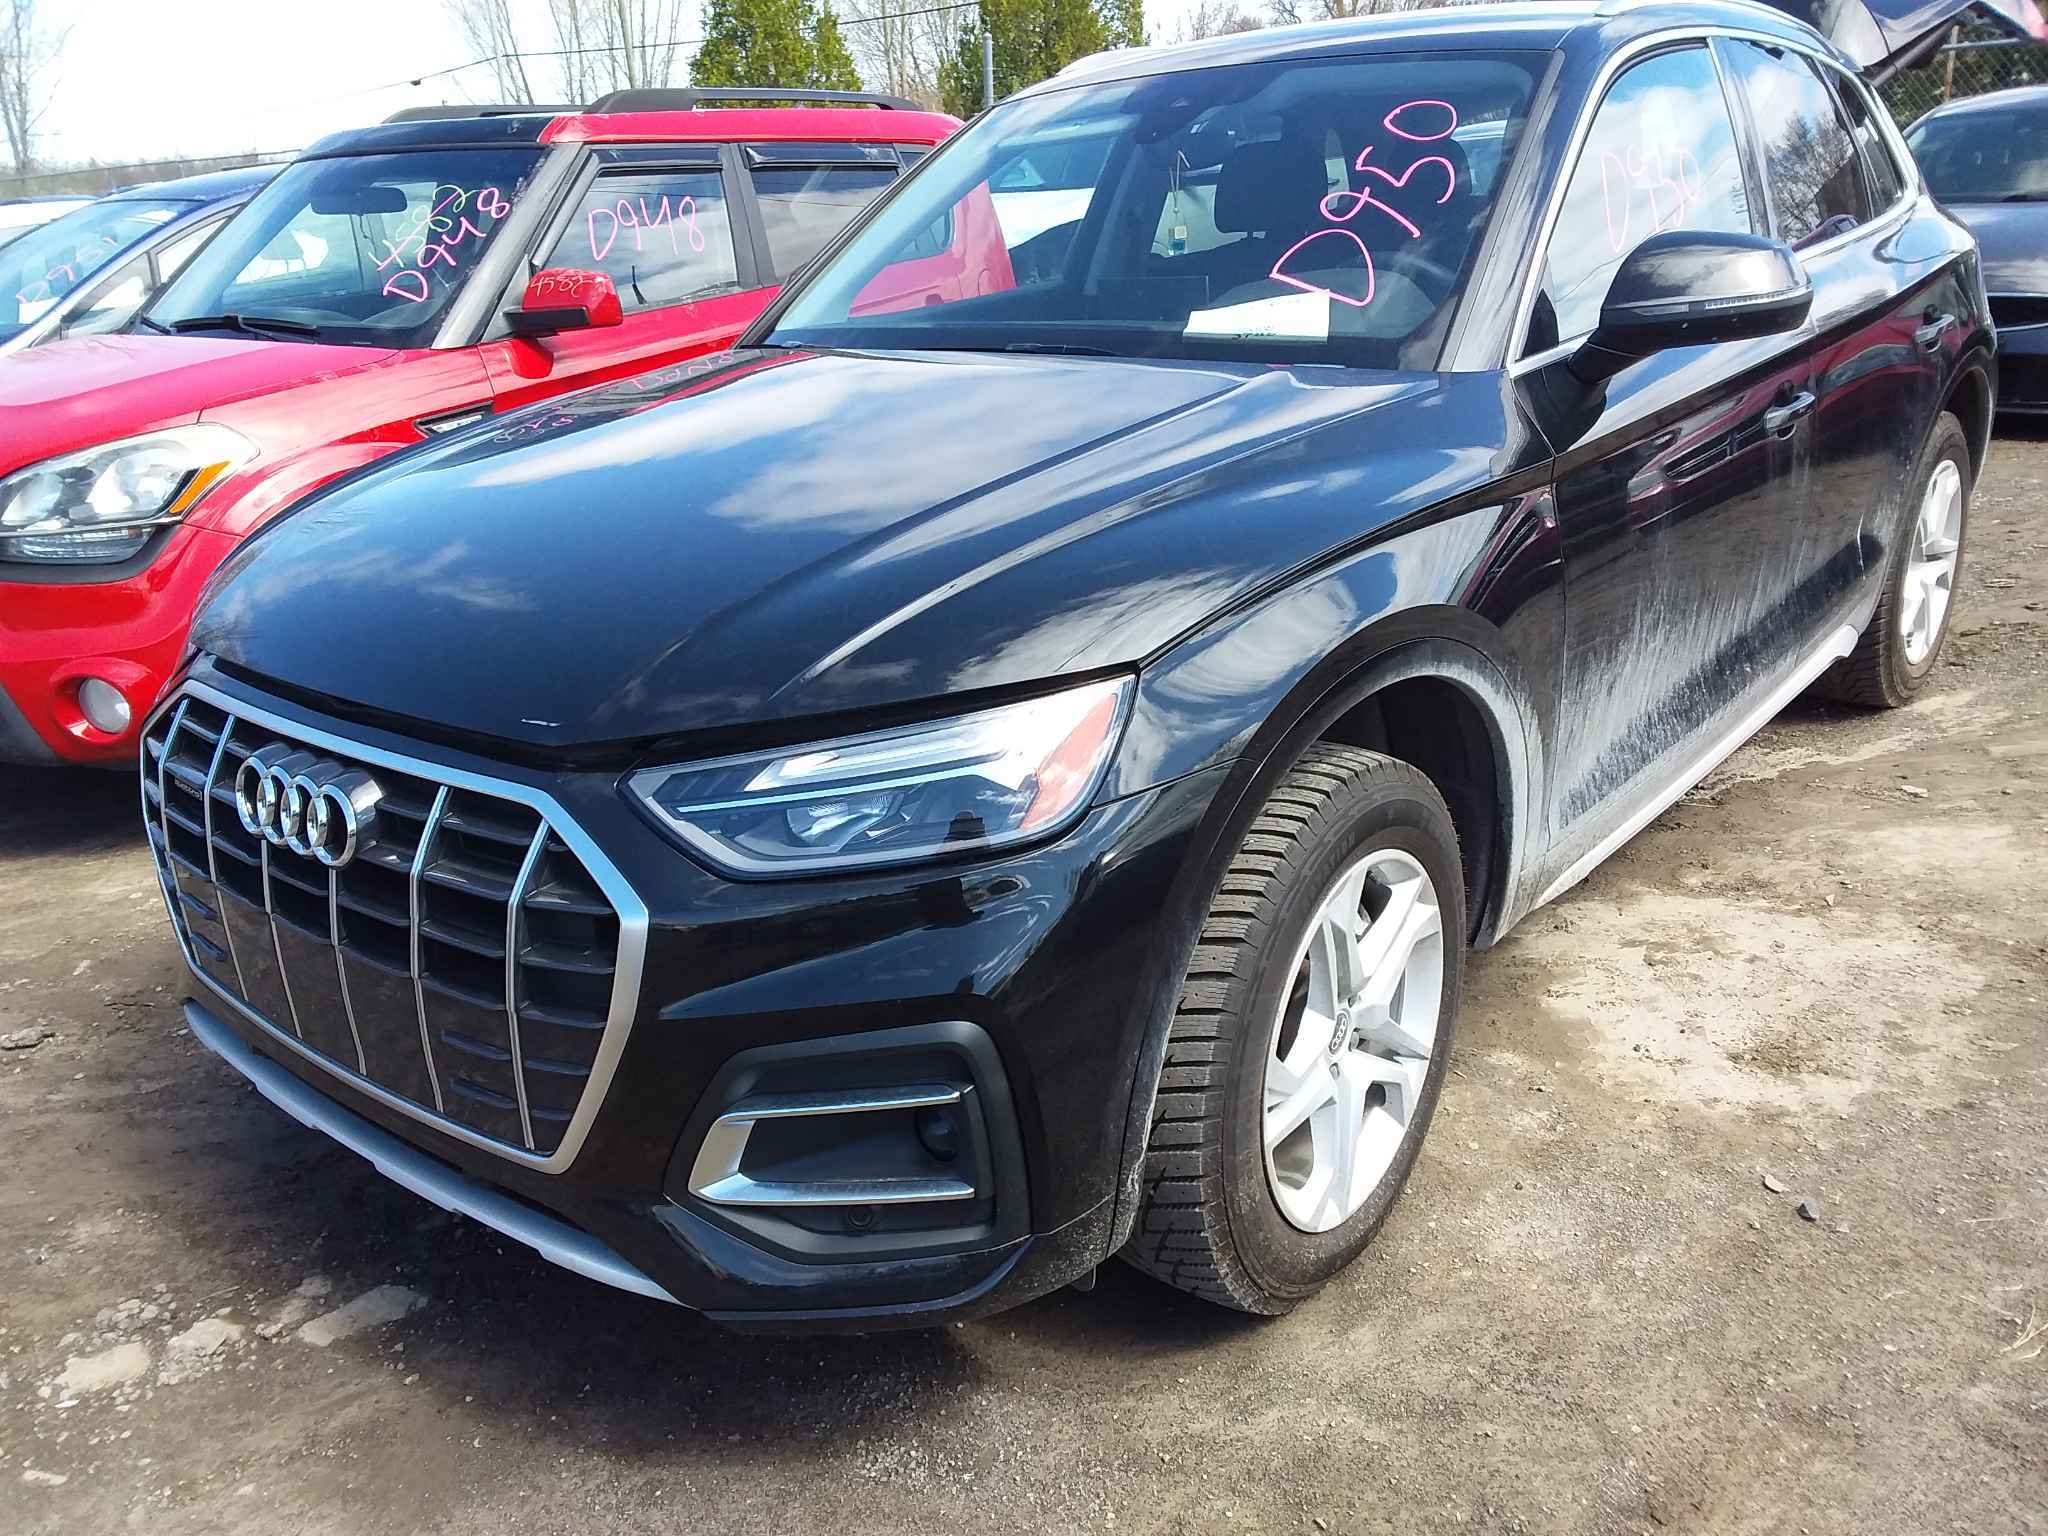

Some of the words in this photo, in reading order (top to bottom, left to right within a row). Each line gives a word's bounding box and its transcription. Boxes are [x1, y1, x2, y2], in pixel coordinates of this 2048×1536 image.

[382, 186, 510, 303] D948
[587, 195, 705, 261] D948
[1268, 99, 1458, 307] D950
